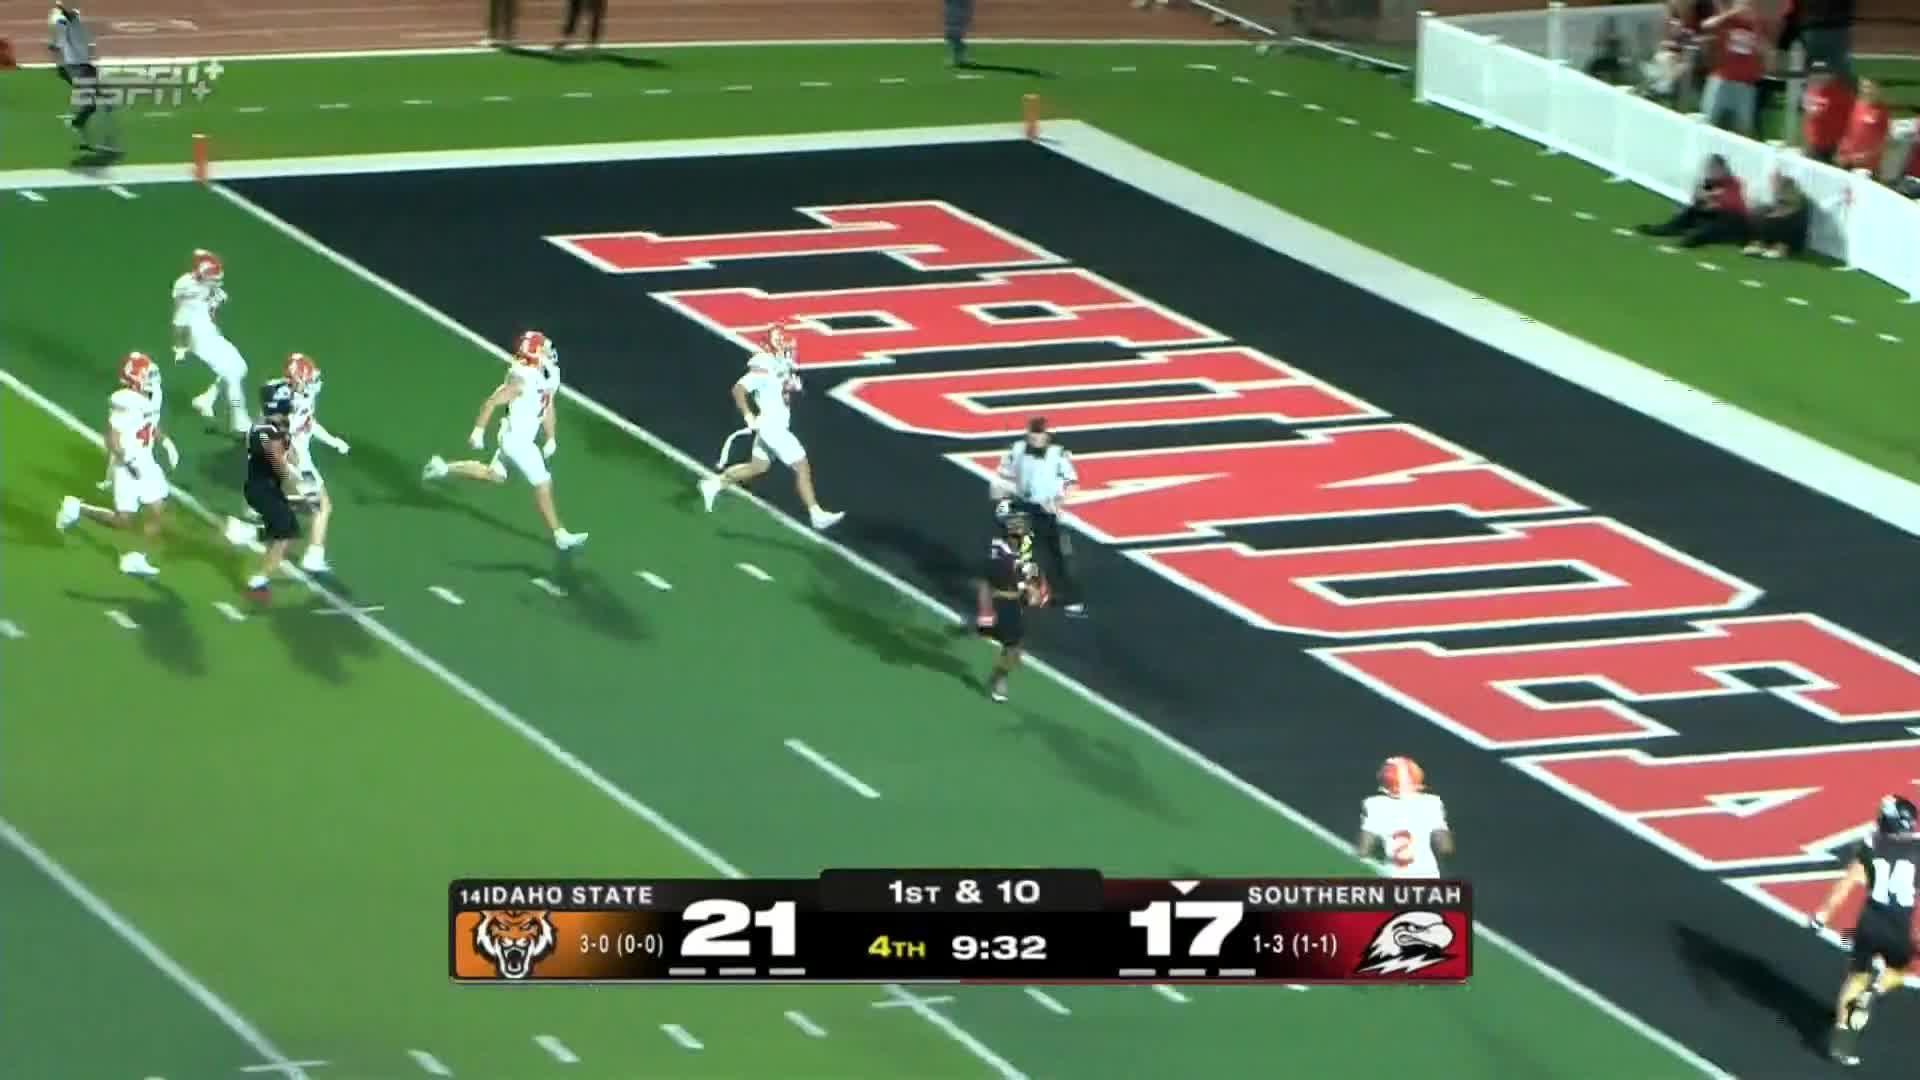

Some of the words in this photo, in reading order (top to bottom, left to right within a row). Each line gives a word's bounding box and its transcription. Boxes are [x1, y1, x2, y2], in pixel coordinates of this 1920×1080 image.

[543, 200, 1920, 988] THUNDER
[1392, 829, 1415, 867] 2
[1872, 858, 1916, 908] 14
